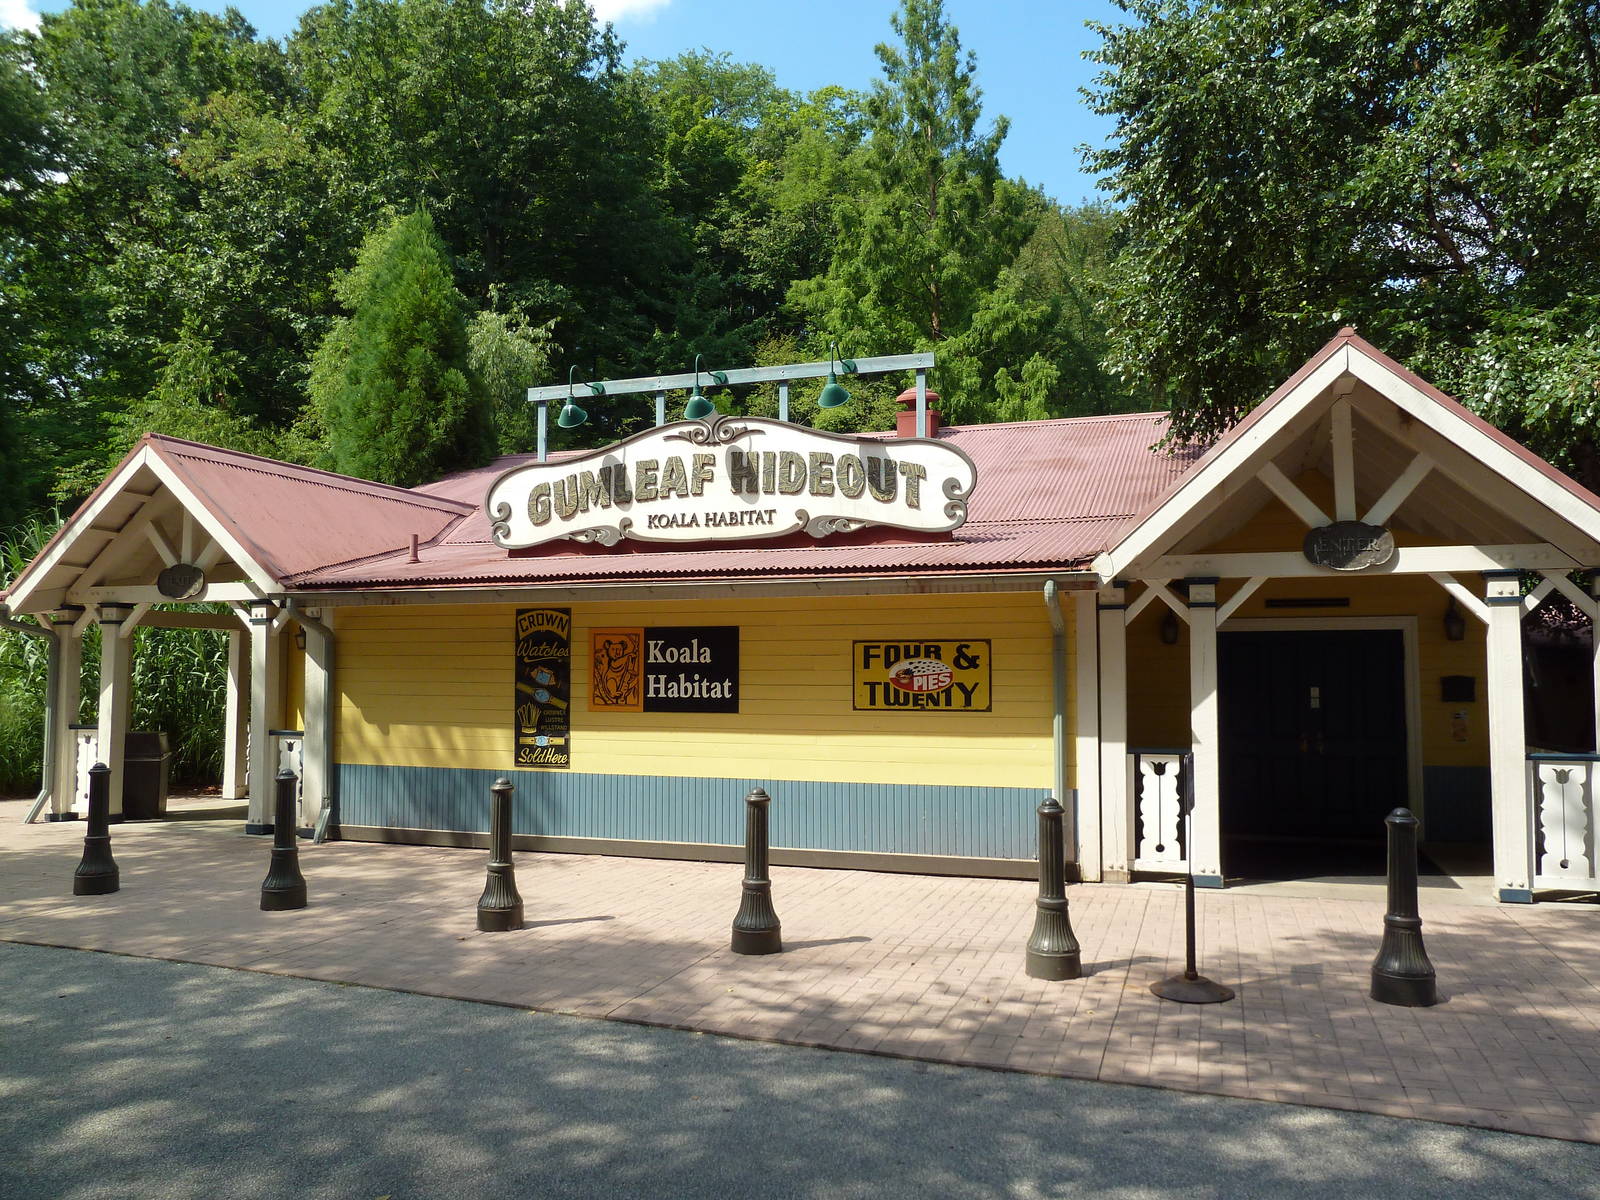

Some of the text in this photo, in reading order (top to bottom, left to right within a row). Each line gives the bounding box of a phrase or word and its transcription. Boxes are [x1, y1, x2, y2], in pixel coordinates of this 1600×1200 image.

[527, 451, 927, 527] GUMLEAF HIDEOUT
[647, 509, 777, 530] KOALA HABITAT
[518, 613, 568, 633] CROWN
[516, 639, 570, 657] Watches
[647, 639, 712, 663] Koala
[863, 643, 980, 670] FOUR &
[647, 674, 732, 699] Habitat
[913, 672, 951, 691] PIES
[863, 681, 980, 708] TWENTY
